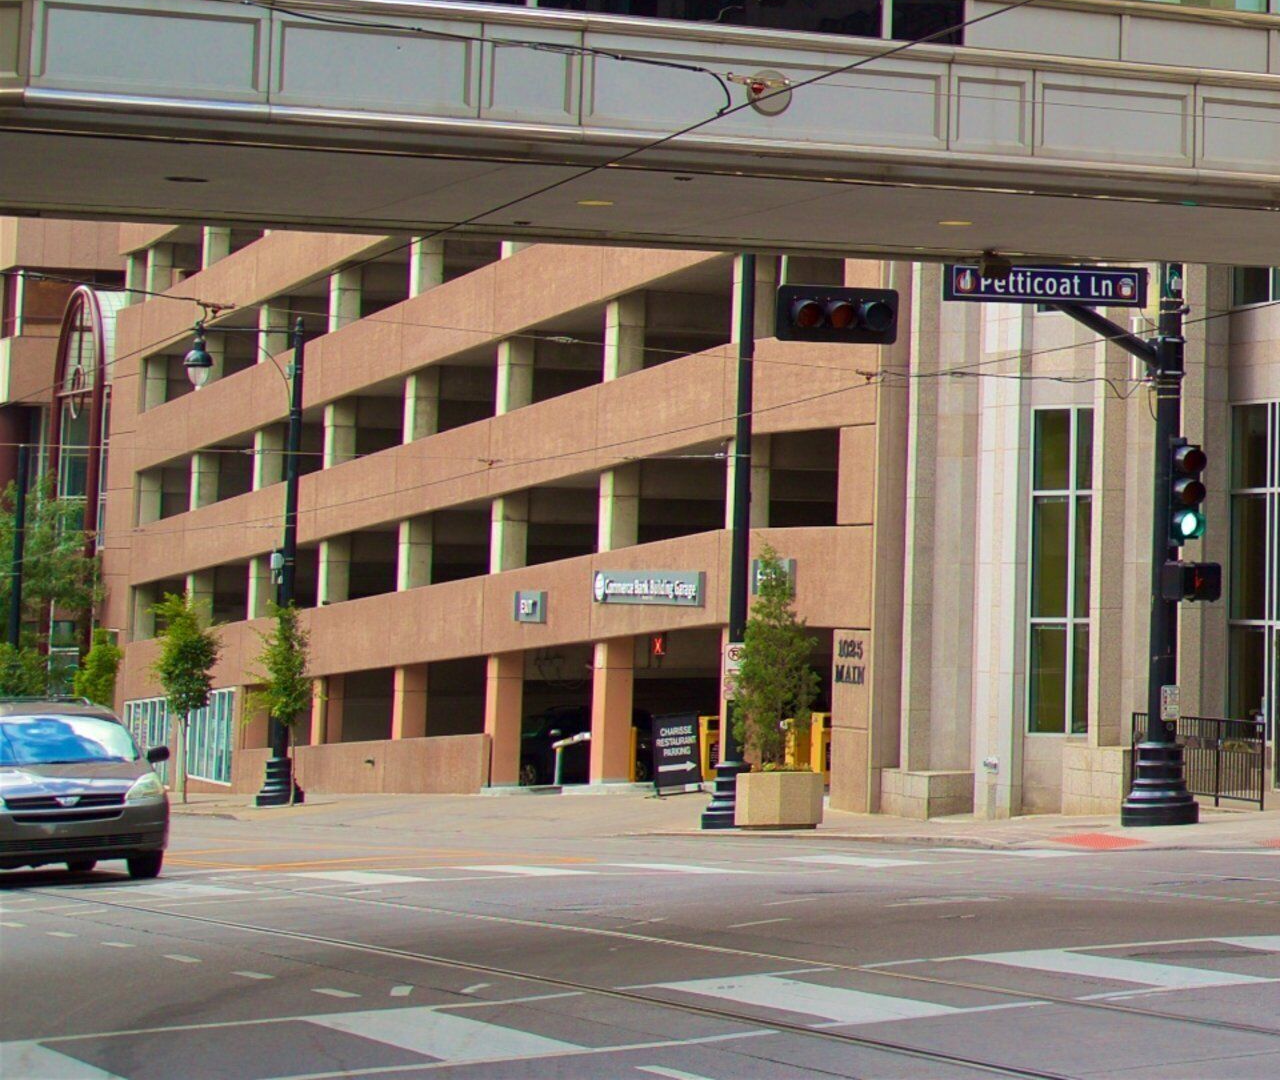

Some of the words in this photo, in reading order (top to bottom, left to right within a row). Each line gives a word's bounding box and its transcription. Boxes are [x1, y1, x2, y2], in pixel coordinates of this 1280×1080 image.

[980, 271, 1081, 297] Petticoat
[1090, 275, 1113, 297] Ln
[675, 580, 697, 599] Garage
[838, 639, 864, 660] 1025
[835, 664, 866, 685] MAIN
[655, 735, 697, 748] RESTAURANT
[663, 746, 691, 757] PARKING
